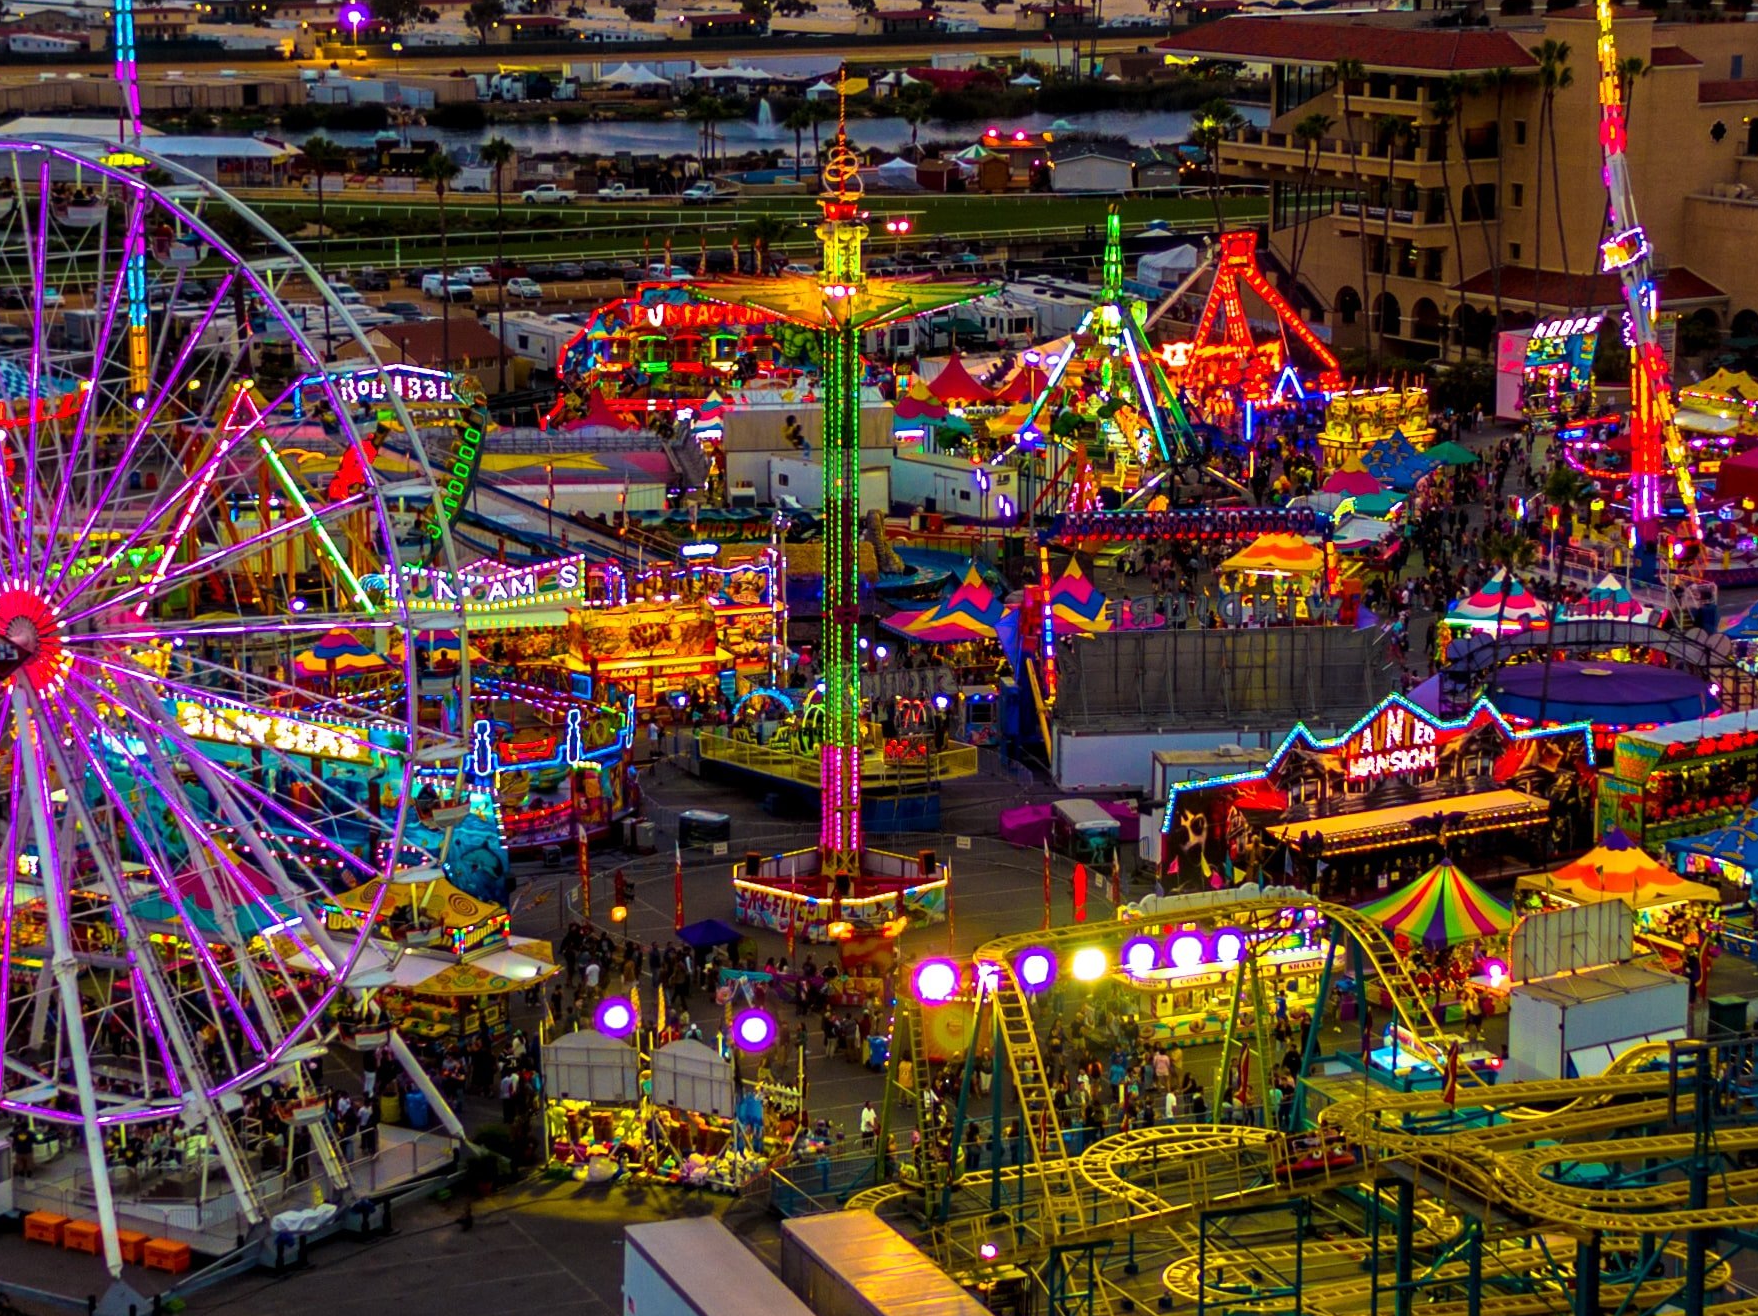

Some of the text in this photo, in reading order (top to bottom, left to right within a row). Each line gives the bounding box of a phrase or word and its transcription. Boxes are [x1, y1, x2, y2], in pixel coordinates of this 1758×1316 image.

[610, 667, 648, 677] NACHOS
[1349, 709, 1436, 755] HAUNTED
[1349, 745, 1436, 779] MANSION
[1287, 959, 1323, 971] SHAKES
[1179, 975, 1212, 986] CONES
